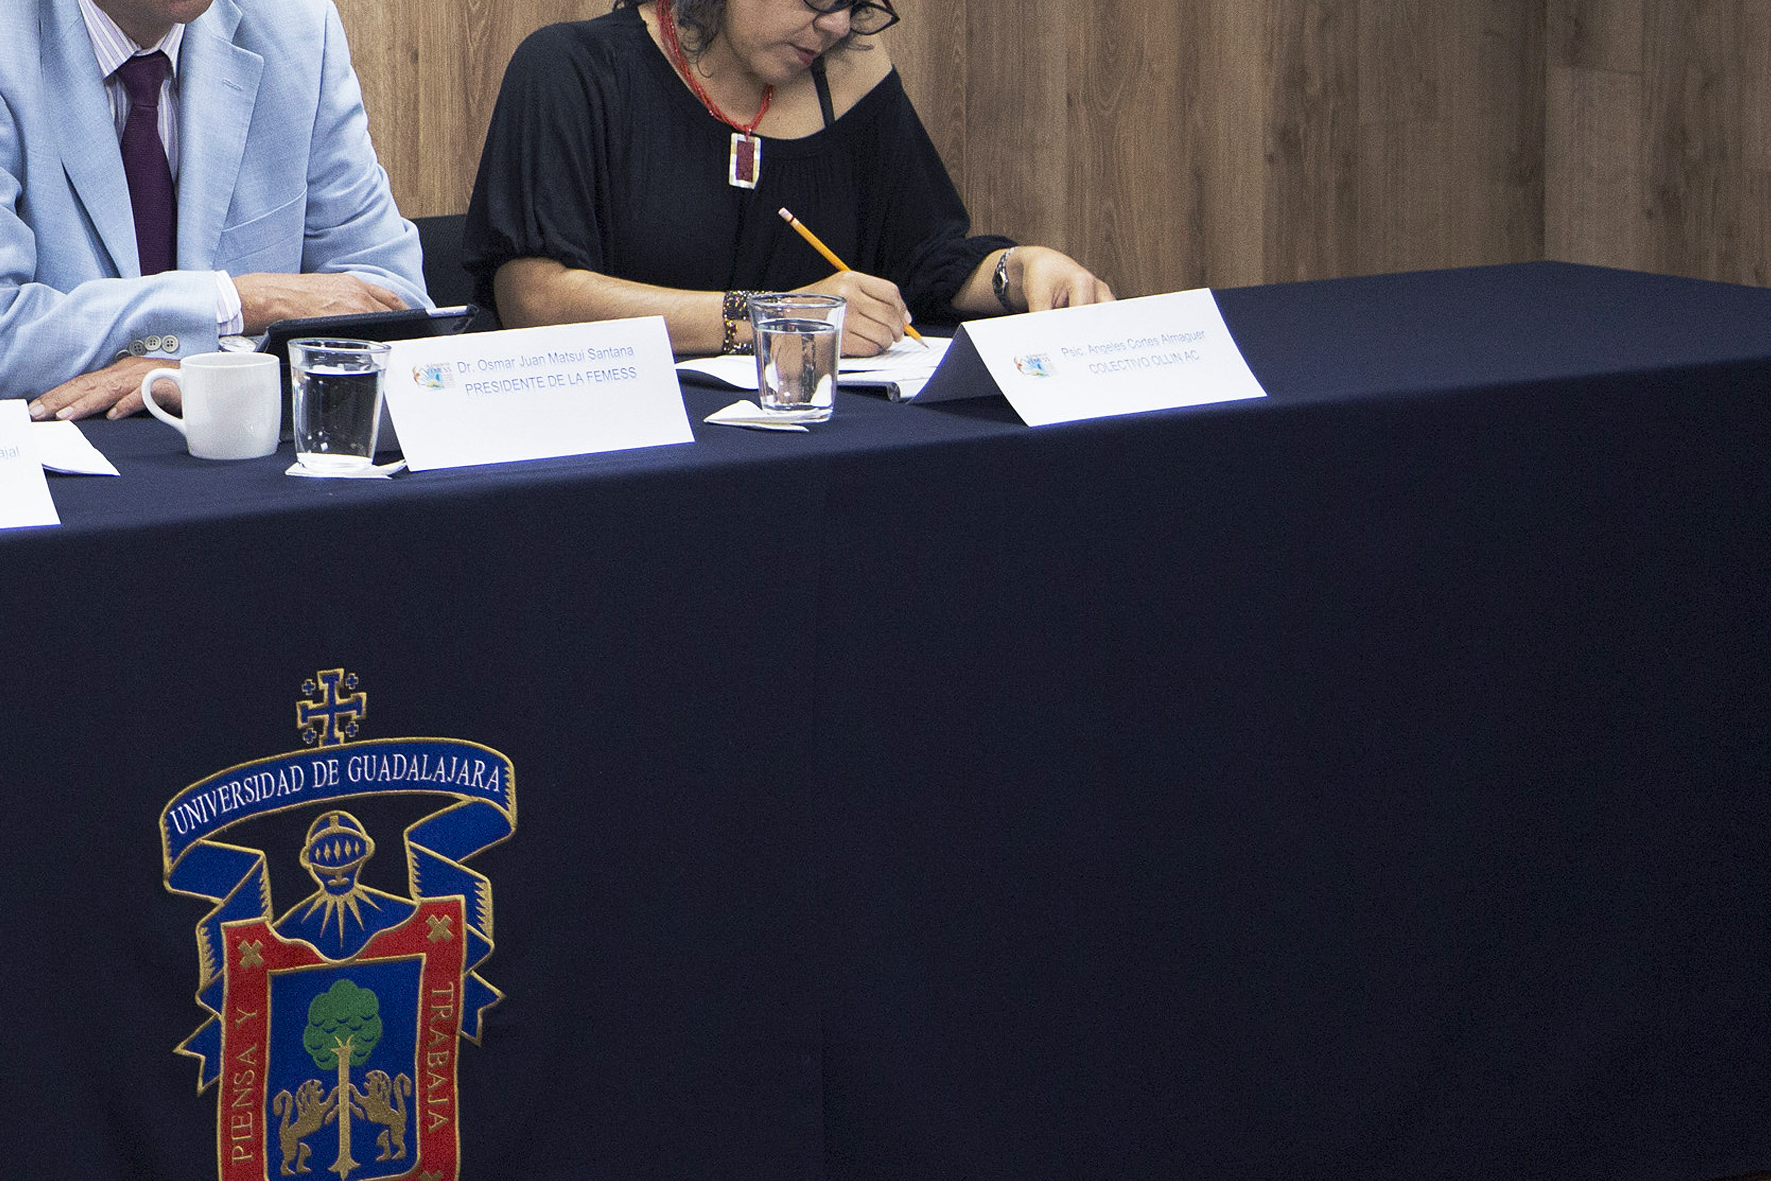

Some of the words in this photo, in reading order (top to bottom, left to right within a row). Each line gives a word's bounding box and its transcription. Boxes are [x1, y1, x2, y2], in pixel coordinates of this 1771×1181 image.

[457, 361, 475, 374] Dr.
[477, 359, 515, 371] Osmar
[519, 355, 546, 367] Juan
[547, 349, 585, 364] Matsui
[587, 346, 634, 361] Santana
[1089, 357, 1150, 374] COLECTIVO
[1151, 353, 1183, 366] OLLIN
[1184, 350, 1200, 361] AC
[465, 376, 546, 396] PRESIDENTE
[547, 374, 566, 388] DE
[567, 372, 585, 387] LA
[586, 366, 638, 384] FEMESS
[169, 765, 305, 834] UNIVERSIDAD
[312, 758, 340, 789] DE
[347, 753, 501, 793] GUADALAJARA
[235, 1006, 258, 1029] Y
[426, 981, 454, 1134] TRABAJA
[231, 1043, 258, 1164] PIENSA
